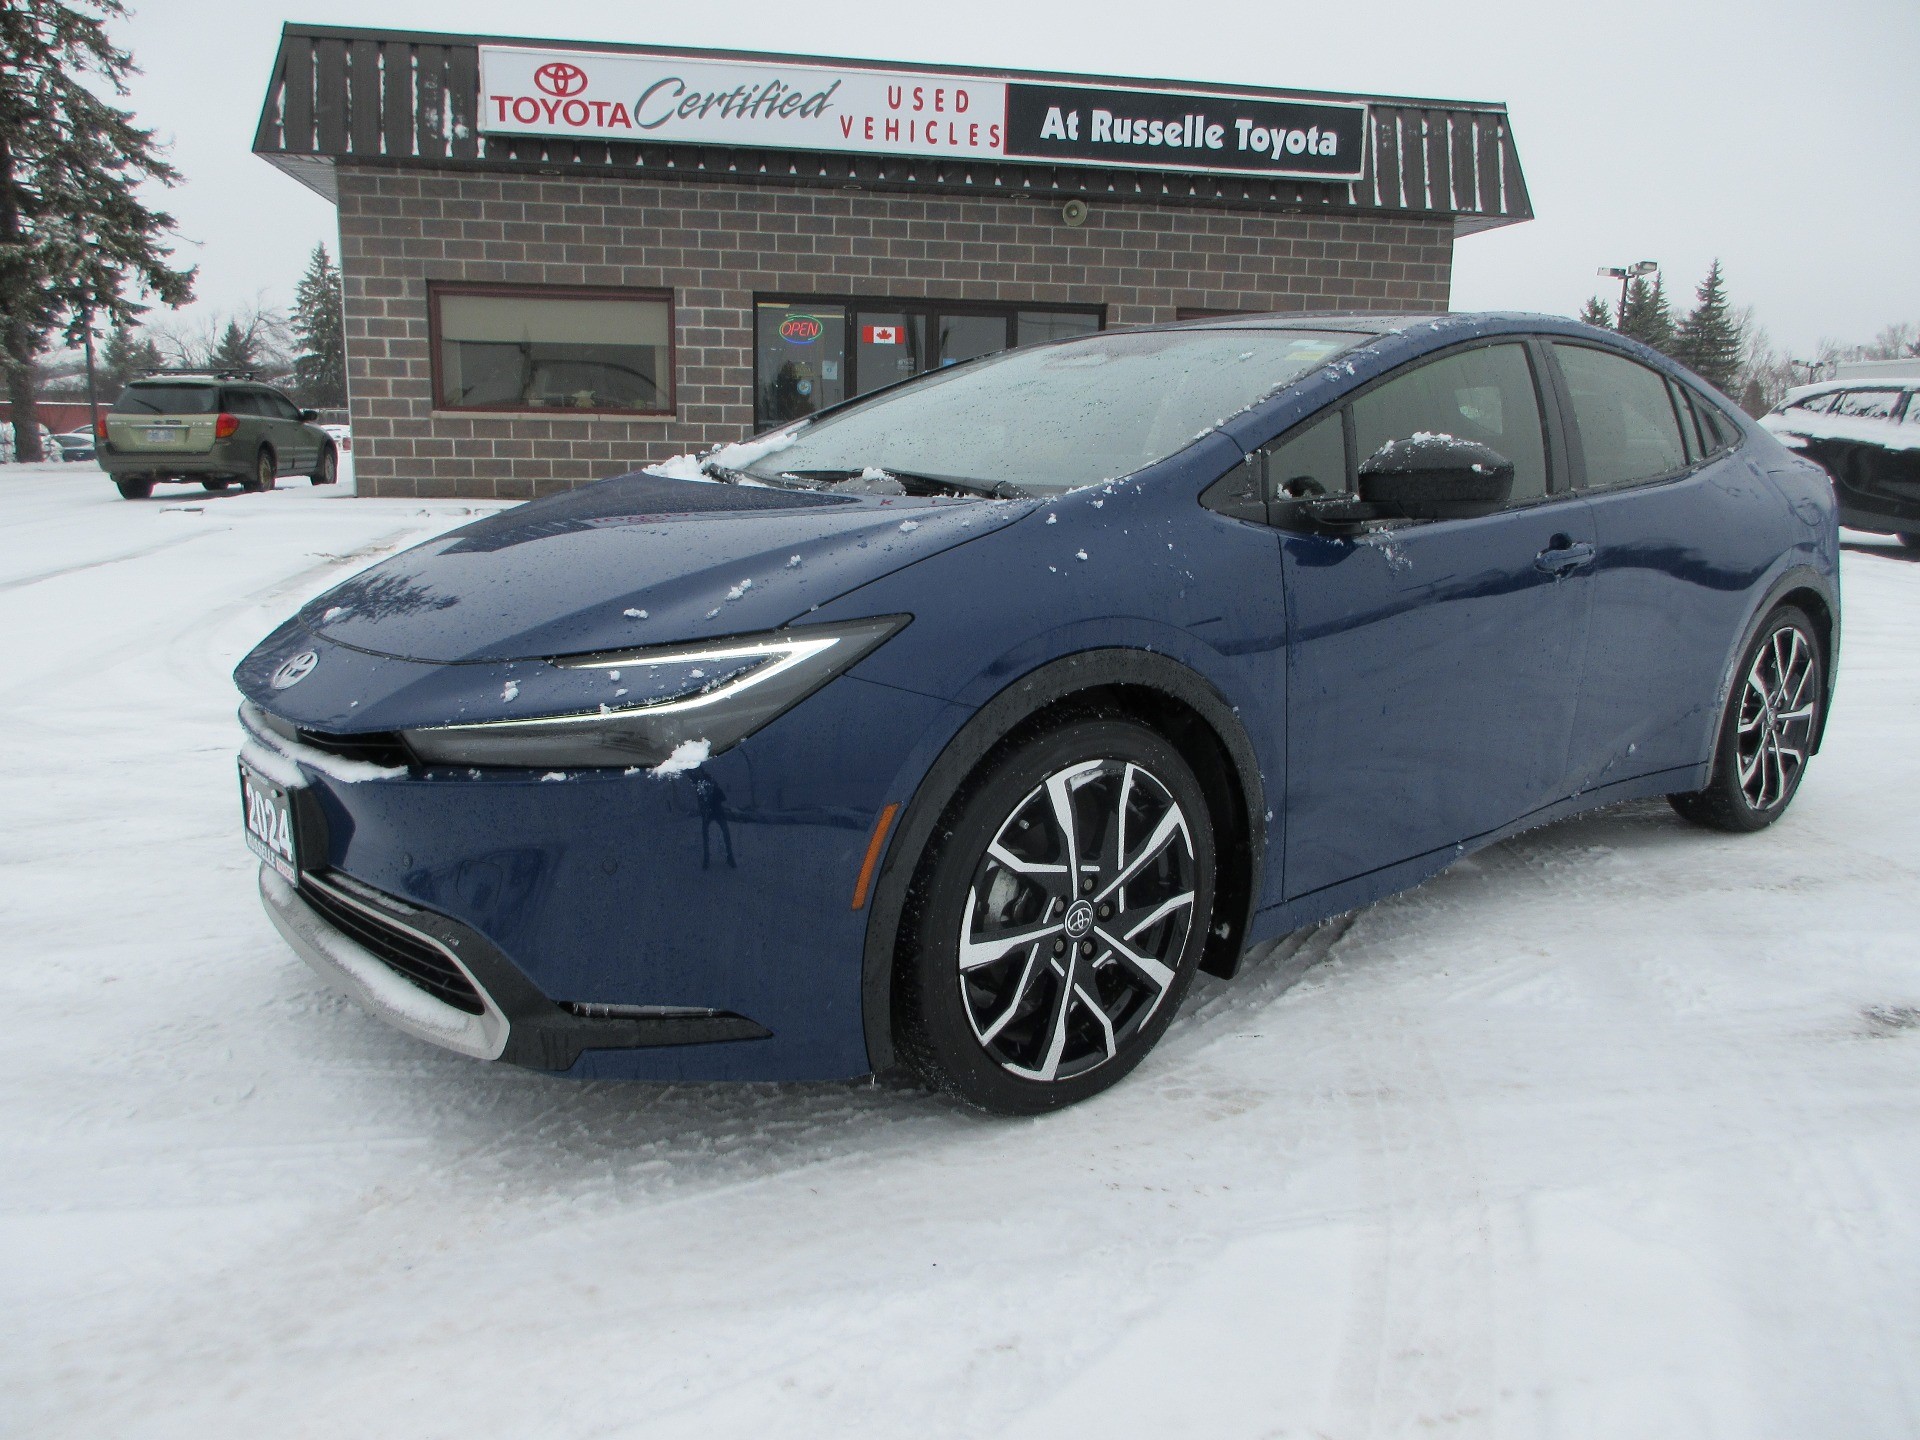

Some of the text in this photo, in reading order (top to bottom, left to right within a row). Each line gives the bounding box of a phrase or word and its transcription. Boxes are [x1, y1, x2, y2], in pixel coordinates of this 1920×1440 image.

[490, 77, 842, 130] TOYOTA Certified
[888, 85, 970, 113] USED
[841, 115, 1000, 148] VEHICLES
[1040, 107, 1337, 160] At Russelle Toyota
[781, 321, 819, 337] OPEN
[246, 782, 293, 862] 2024
